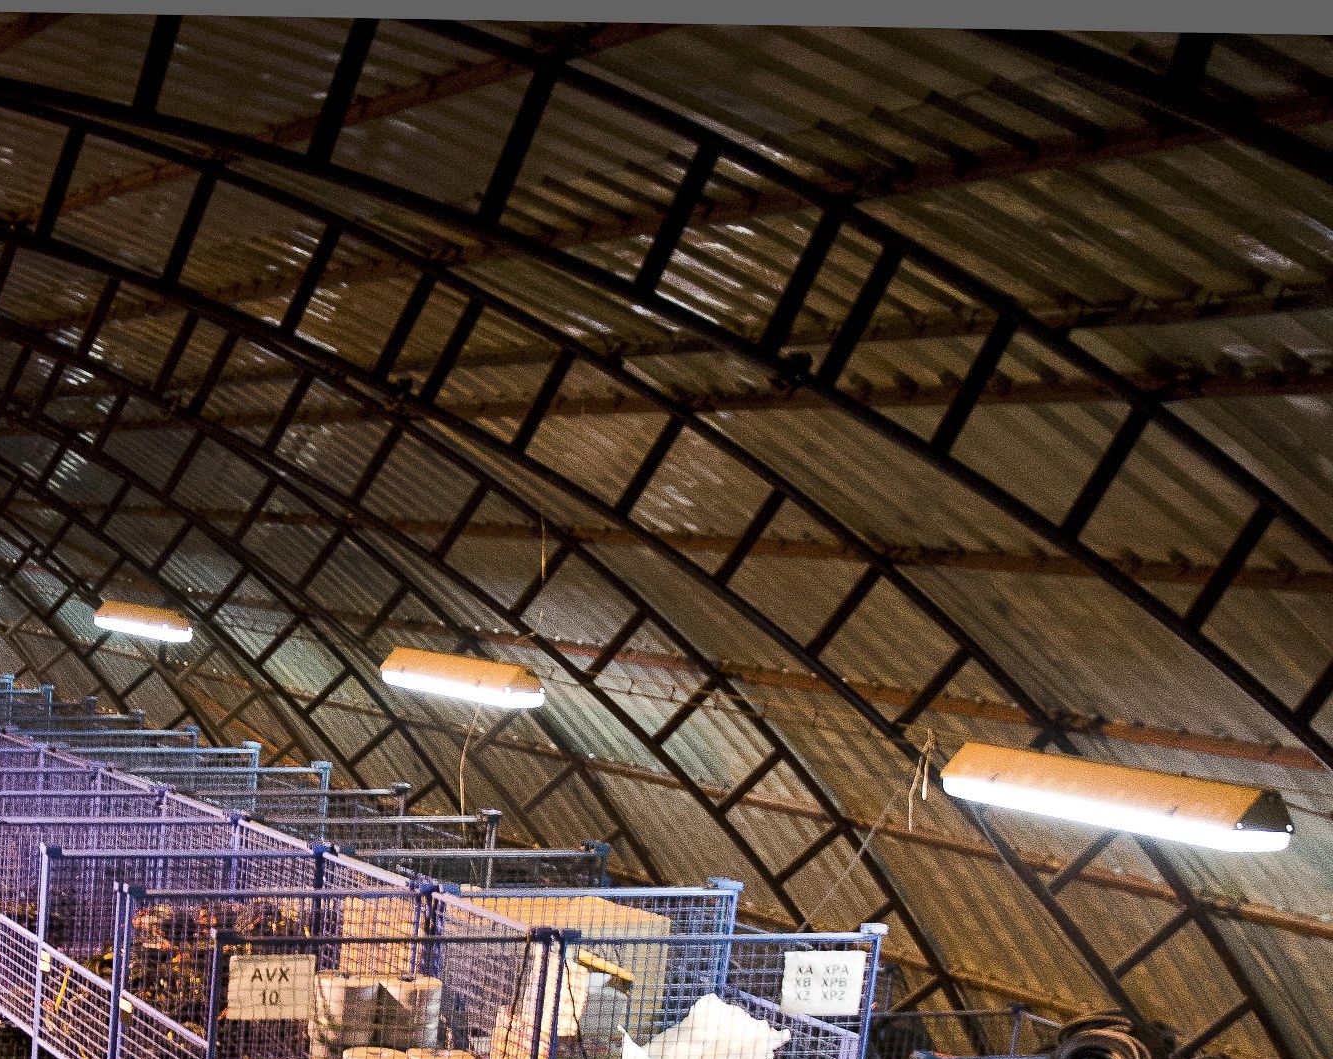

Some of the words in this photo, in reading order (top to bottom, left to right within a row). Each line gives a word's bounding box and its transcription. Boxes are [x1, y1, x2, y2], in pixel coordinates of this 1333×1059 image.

[797, 965, 813, 974] XA
[825, 965, 849, 974] XPA
[250, 968, 292, 984] AVX
[795, 978, 810, 987] XB
[260, 989, 281, 1006] 10
[795, 992, 810, 1000] XZ
[821, 991, 845, 1000] XPZ
